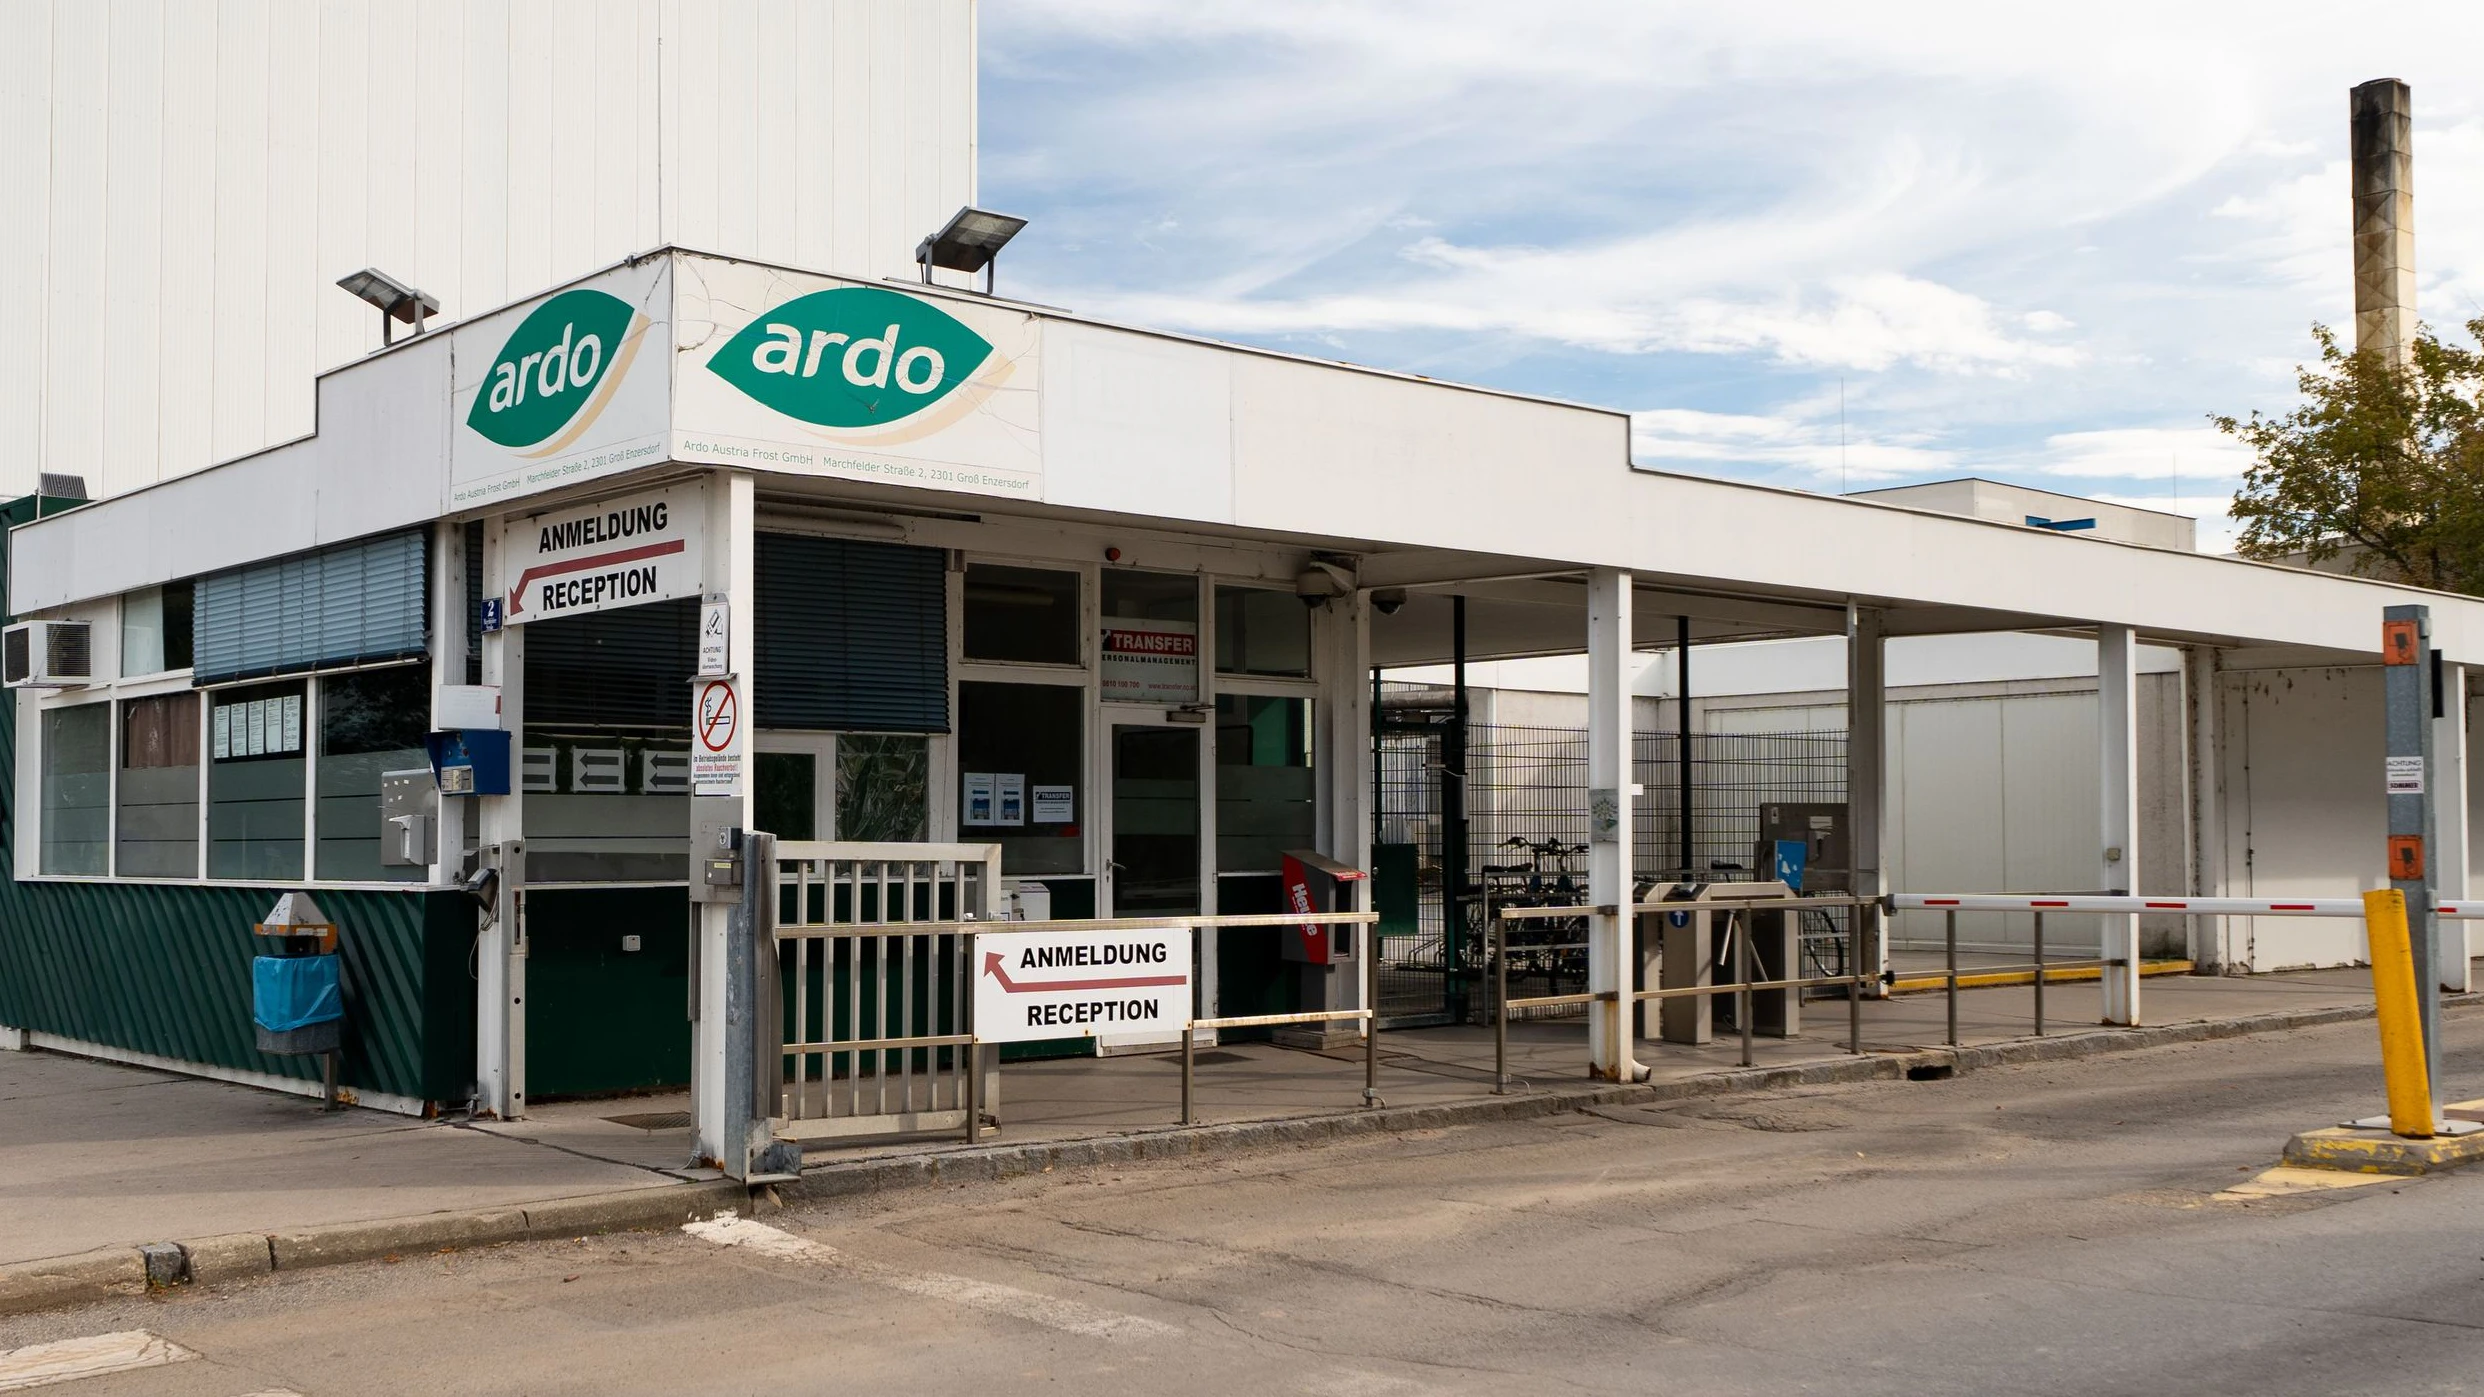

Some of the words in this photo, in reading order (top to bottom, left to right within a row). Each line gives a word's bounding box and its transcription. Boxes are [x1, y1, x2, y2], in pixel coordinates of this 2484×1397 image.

[488, 322, 602, 414] ardo
[752, 323, 946, 395] ardo
[454, 493, 467, 501] Ardo
[467, 487, 487, 500] Austria
[487, 484, 501, 494] Frost
[502, 477, 521, 492] GmbH
[526, 467, 561, 484] Marchfelder
[562, 463, 582, 477] Straße
[583, 459, 590, 472] 2,
[591, 456, 607, 468] 2301
[609, 452, 625, 464] Groß
[626, 442, 661, 460] Enzersdorf
[683, 440, 708, 453] Ardo
[712, 443, 750, 459] Austria
[752, 448, 779, 462] Frost
[782, 451, 813, 465] GmbH
[823, 456, 880, 473] Marchfelder
[883, 462, 915, 477] Straße
[918, 468, 928, 480] 2,
[930, 469, 954, 482] 2301
[957, 472, 980, 486] Groß
[982, 475, 1030, 490] Enzersdorf
[538, 502, 668, 554] ANMELDUNG
[488, 600, 494, 617] 2
[543, 565, 657, 611] RECEPTION
[1102, 654, 1197, 666] ERSONALMANAGEMENT
[1113, 633, 1193, 653] TRANSFER
[1020, 942, 1167, 969] ANMELDUNG
[1027, 999, 1158, 1027] RECEPTION
